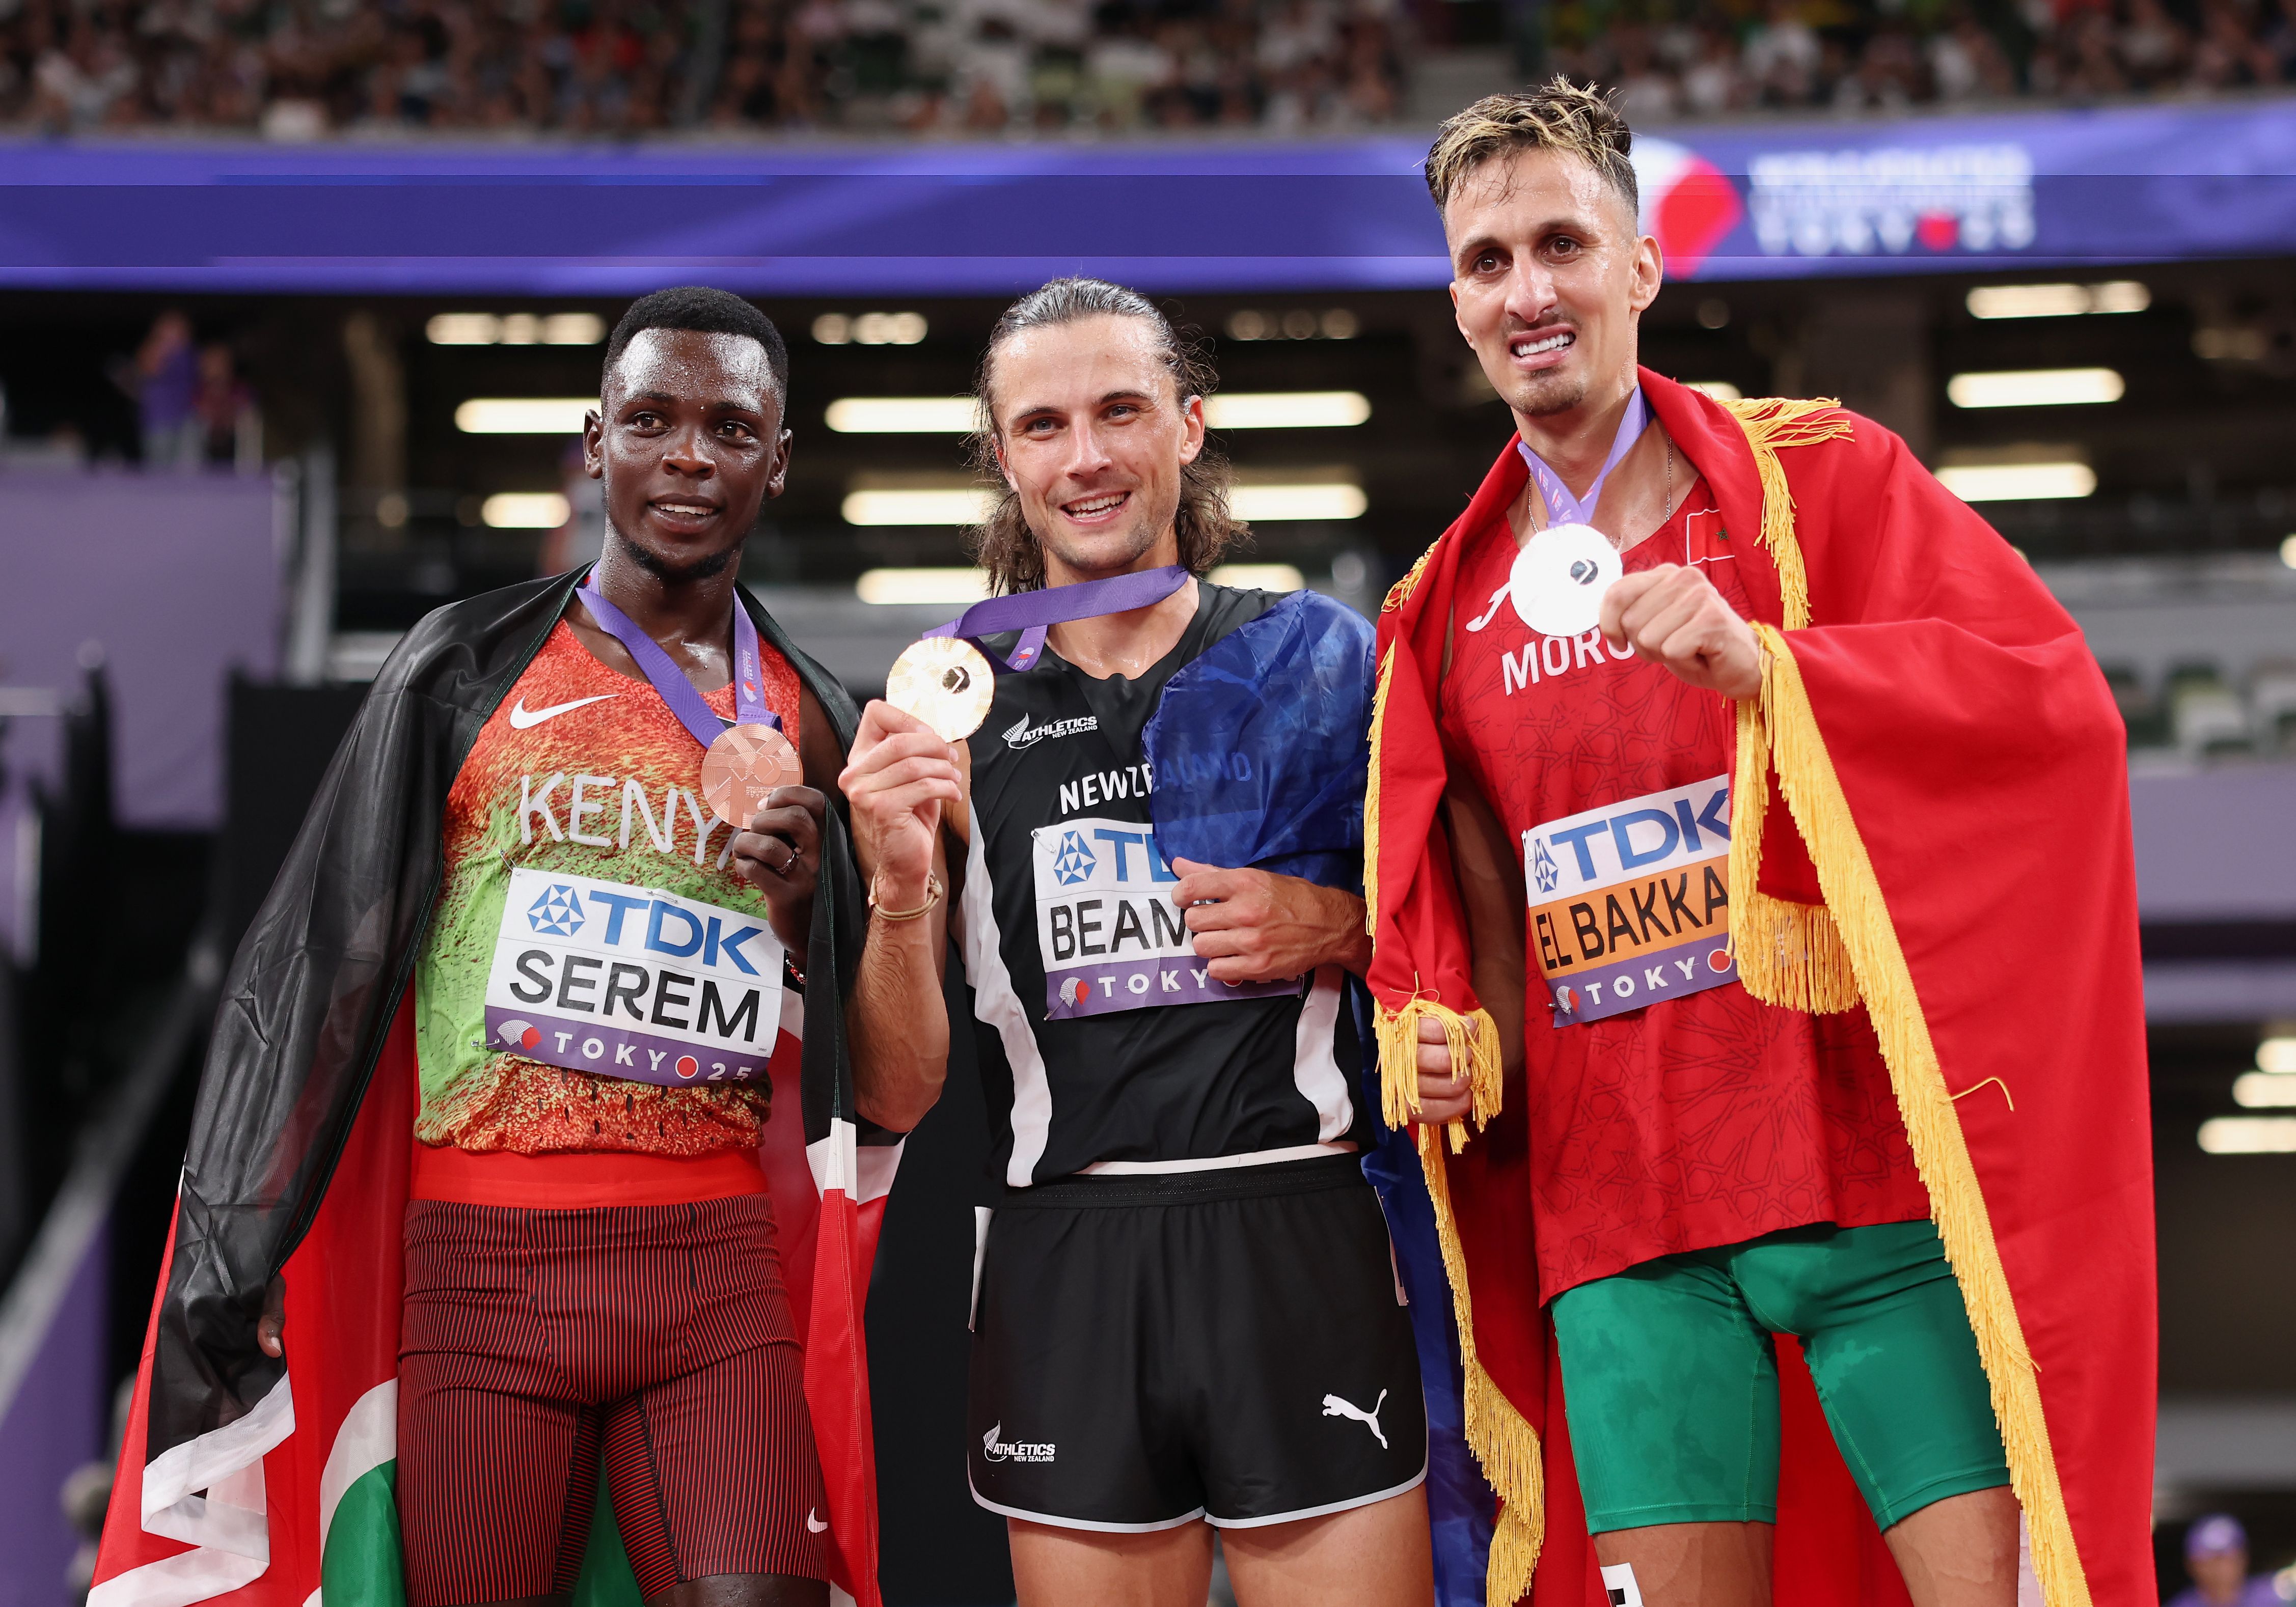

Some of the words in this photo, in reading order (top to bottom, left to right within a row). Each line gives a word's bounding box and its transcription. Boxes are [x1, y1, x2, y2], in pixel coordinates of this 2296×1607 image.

[1022, 716, 1098, 742] ATHLETICS
[1052, 730, 1067, 739] NEW
[1068, 725, 1098, 735] ZEALAND
[1550, 788, 1731, 882] TDK
[589, 890, 763, 977] TDK
[1536, 912, 1573, 971] EL
[509, 949, 760, 1043] SEREM
[707, 1062, 752, 1081] 25
[993, 1440, 1056, 1456] ATHLETICS
